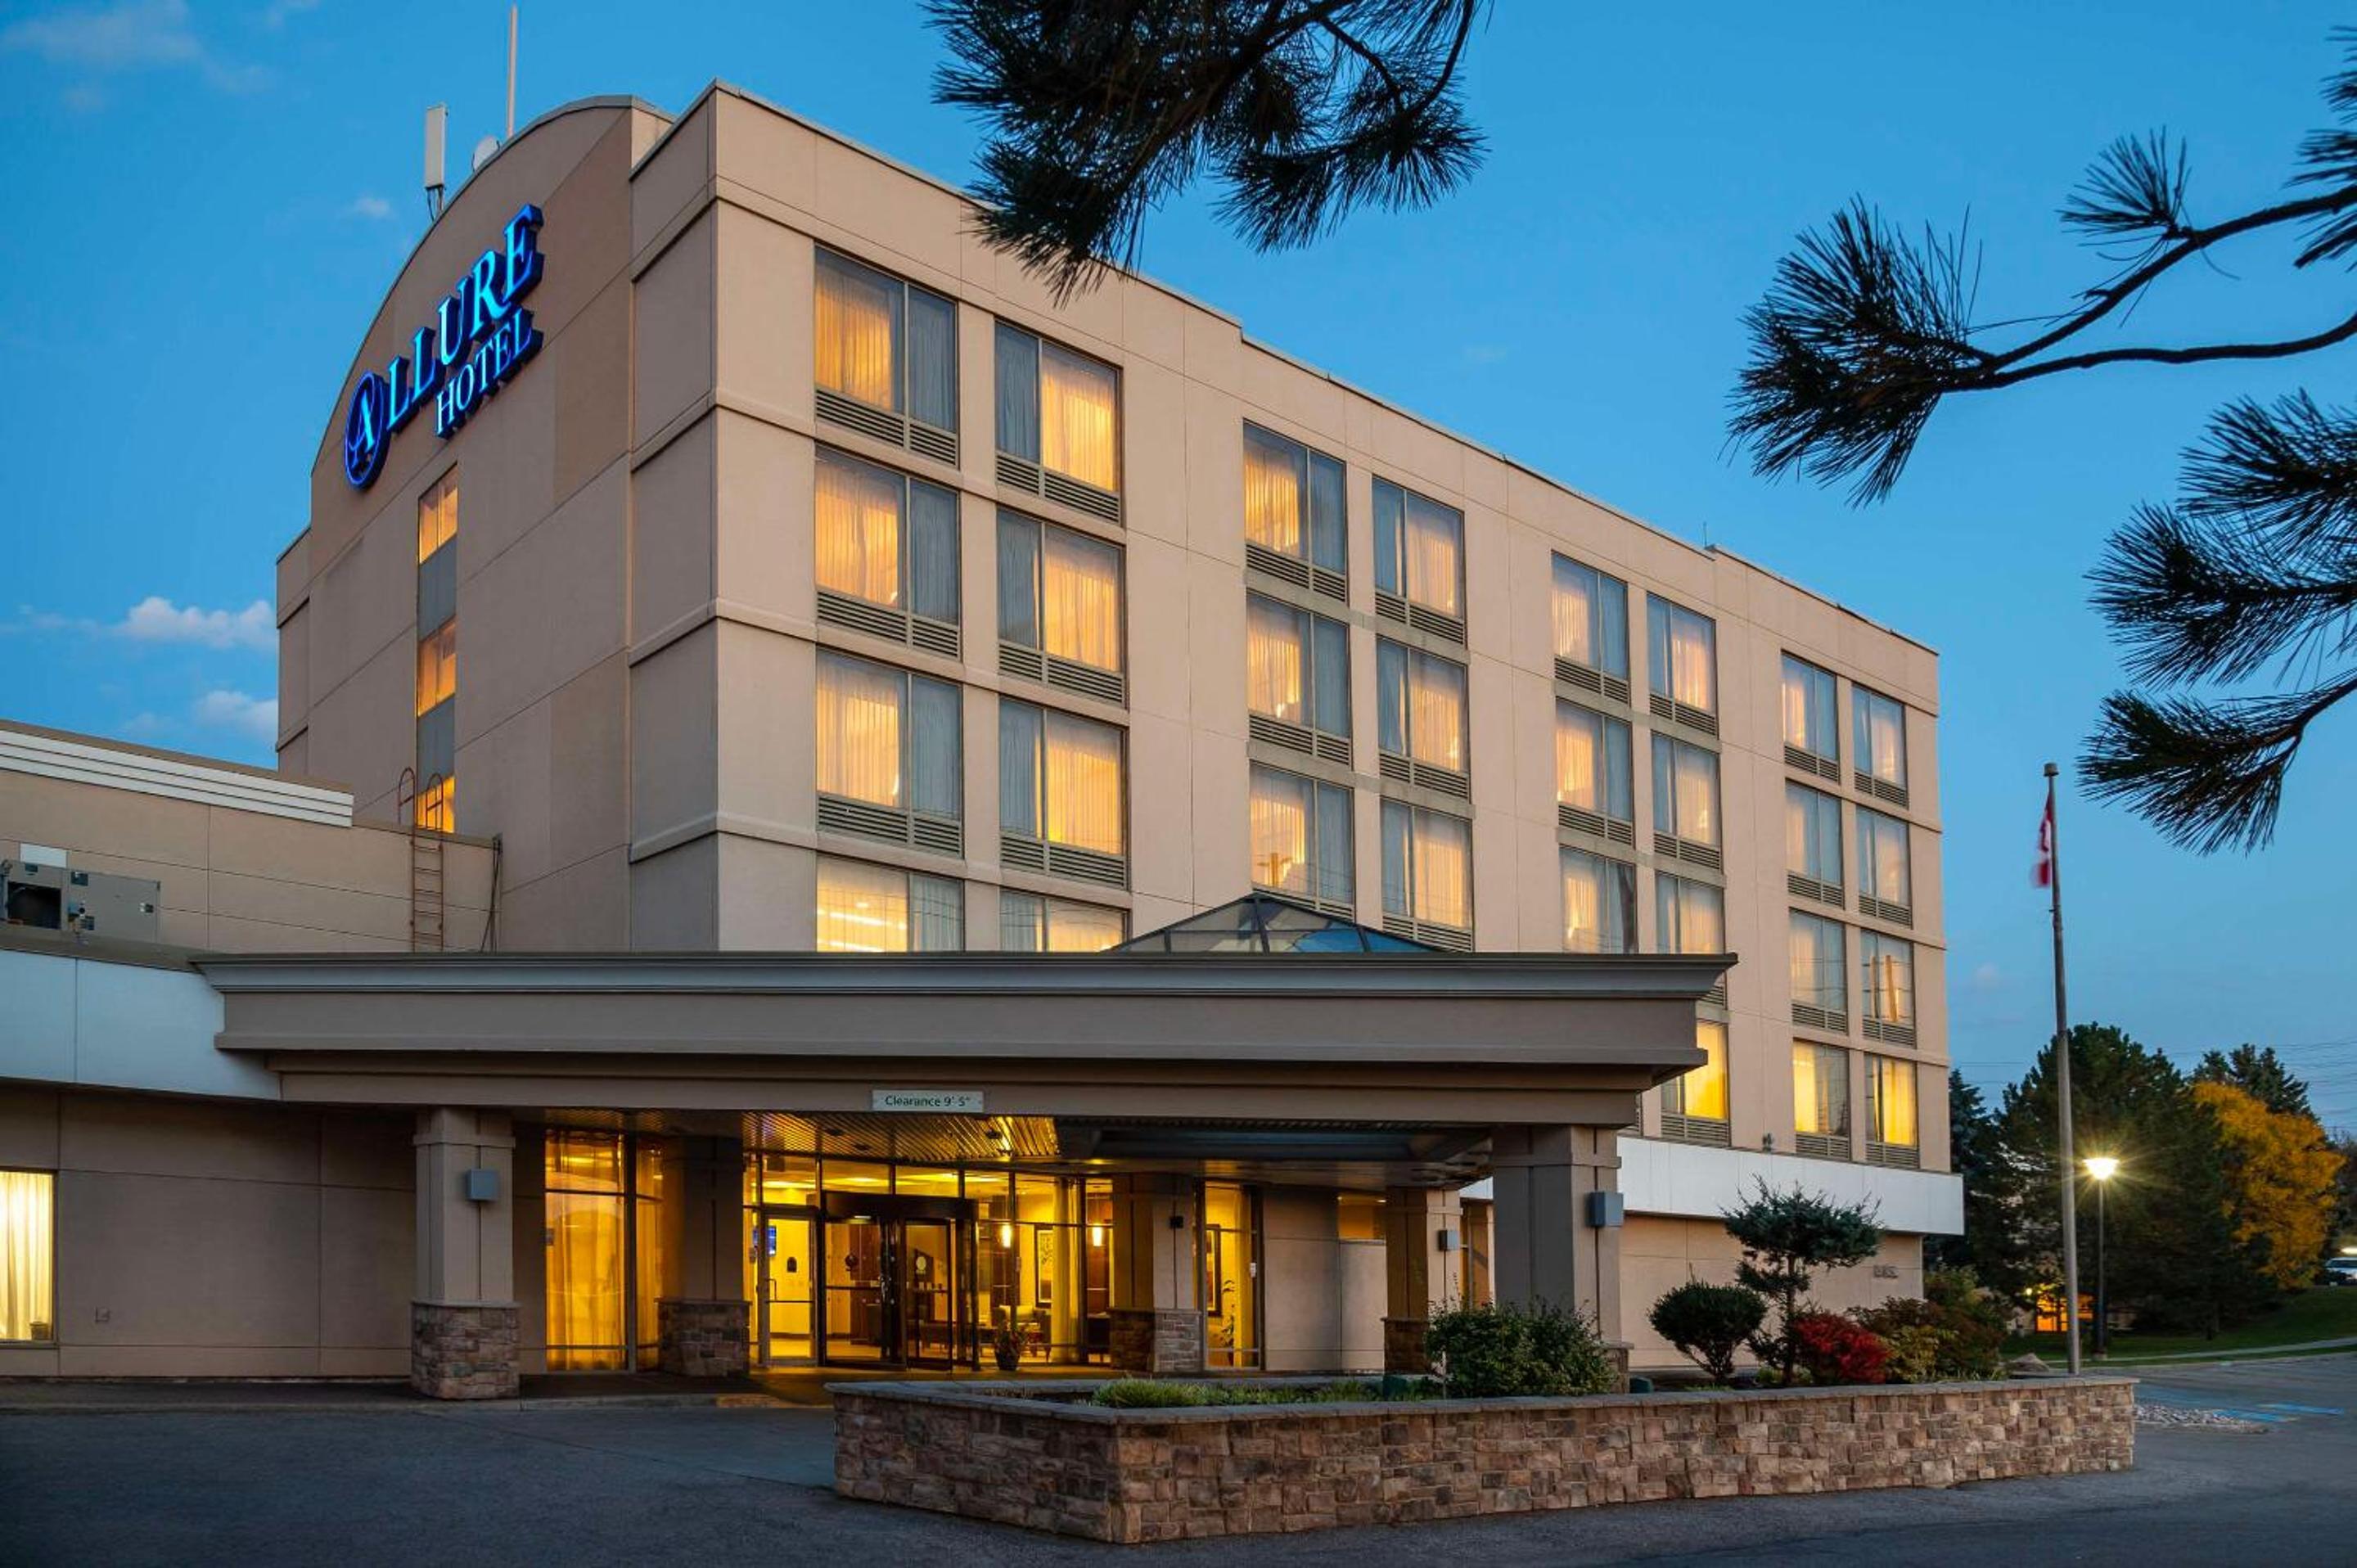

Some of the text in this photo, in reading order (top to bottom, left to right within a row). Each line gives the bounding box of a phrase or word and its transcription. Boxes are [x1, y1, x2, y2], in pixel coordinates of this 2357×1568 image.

[345, 204, 544, 487] ALLURE
[435, 307, 543, 439] HOTEL
[885, 1095, 940, 1106] Clearance
